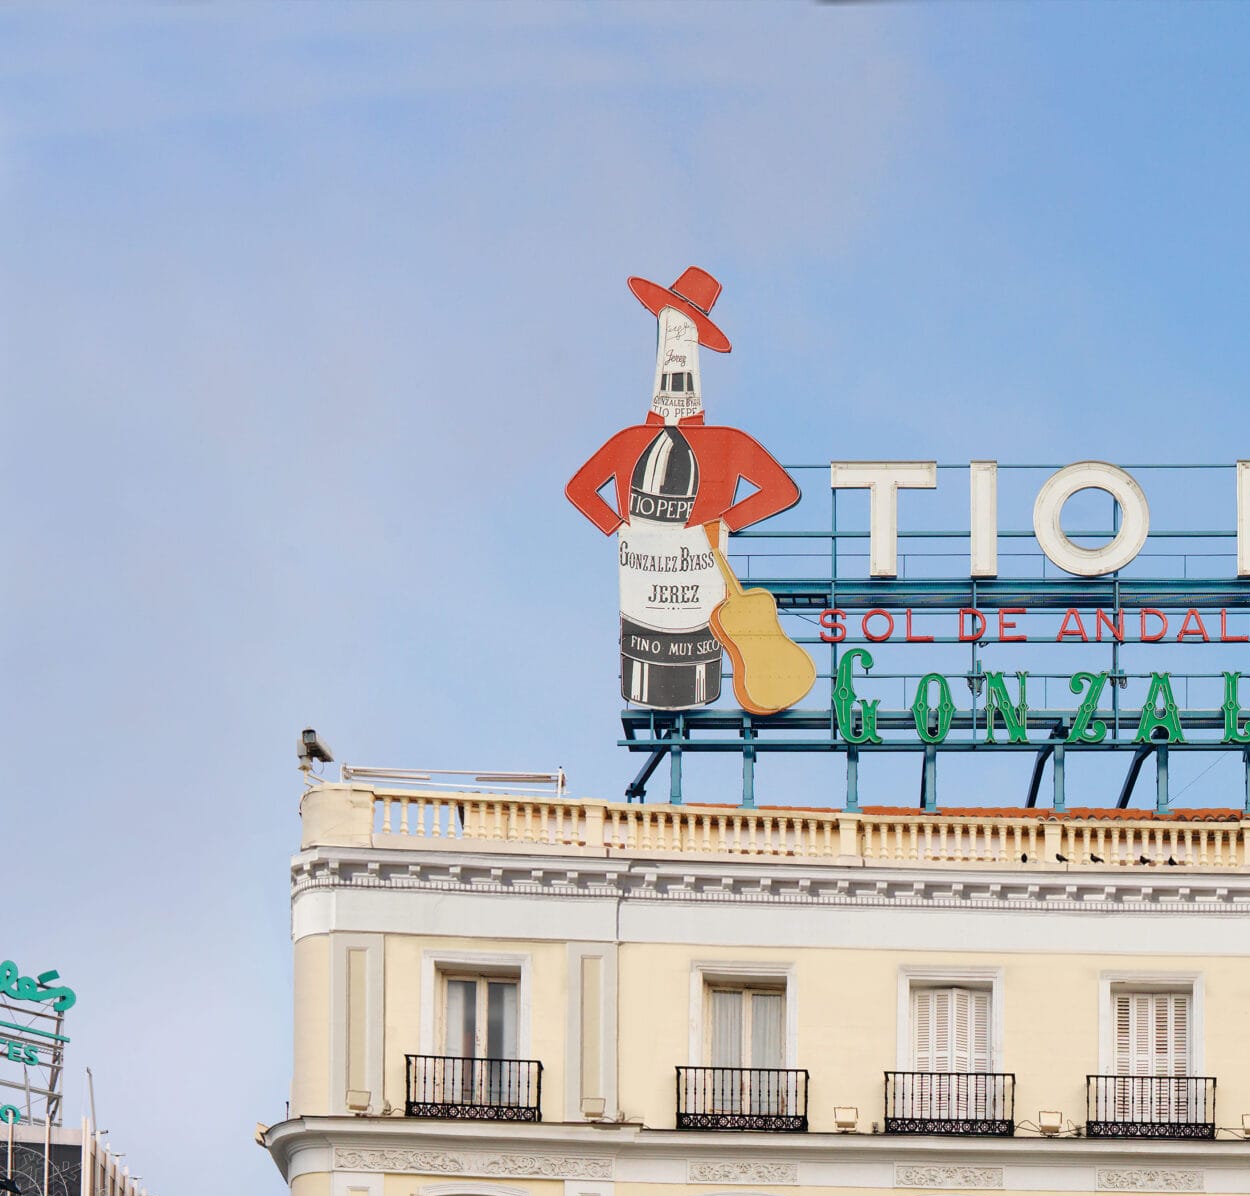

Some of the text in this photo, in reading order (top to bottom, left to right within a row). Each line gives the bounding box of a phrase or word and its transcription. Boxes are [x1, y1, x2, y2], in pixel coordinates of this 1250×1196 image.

[630, 493, 655, 515] TIO
[831, 460, 1150, 578] TIO
[648, 584, 700, 604] JEREZ
[820, 608, 934, 643] SOL
[959, 608, 1027, 642] DE
[631, 635, 720, 656] FINO MUY SECO
